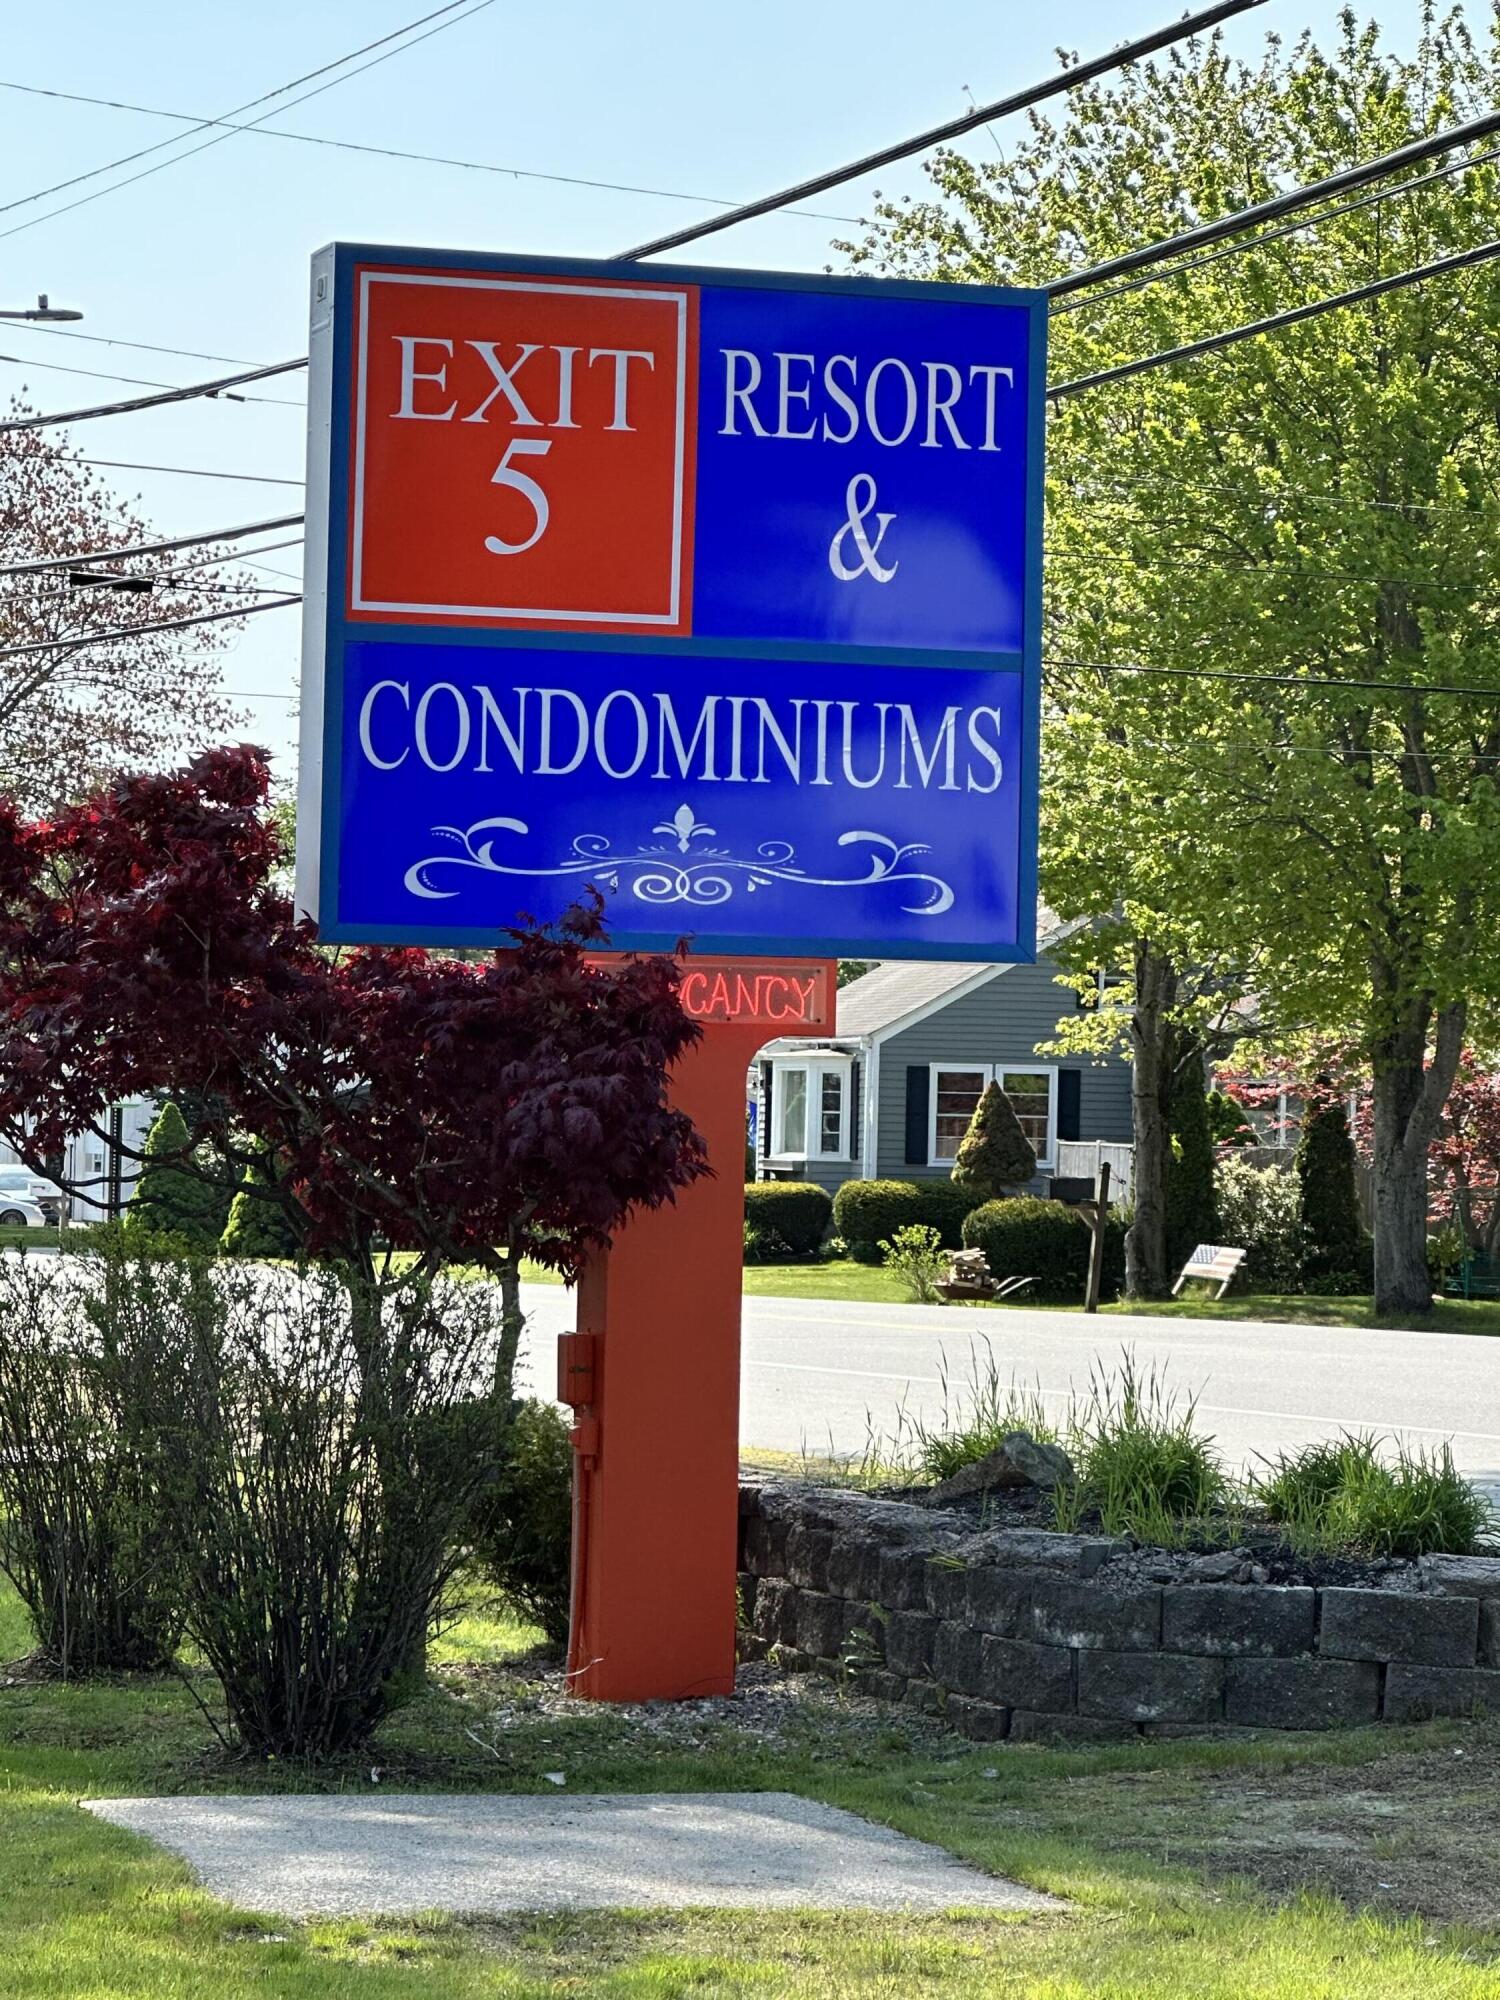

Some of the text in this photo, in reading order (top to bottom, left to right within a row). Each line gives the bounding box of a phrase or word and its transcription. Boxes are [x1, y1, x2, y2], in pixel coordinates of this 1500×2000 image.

[390, 336, 654, 431] EXIT
[718, 349, 1013, 451] RESORT
[484, 438, 552, 555] 5
[828, 473, 899, 584] &
[359, 680, 1003, 794] CONDOMINIUMS
[668, 973, 815, 1019] CANCY
